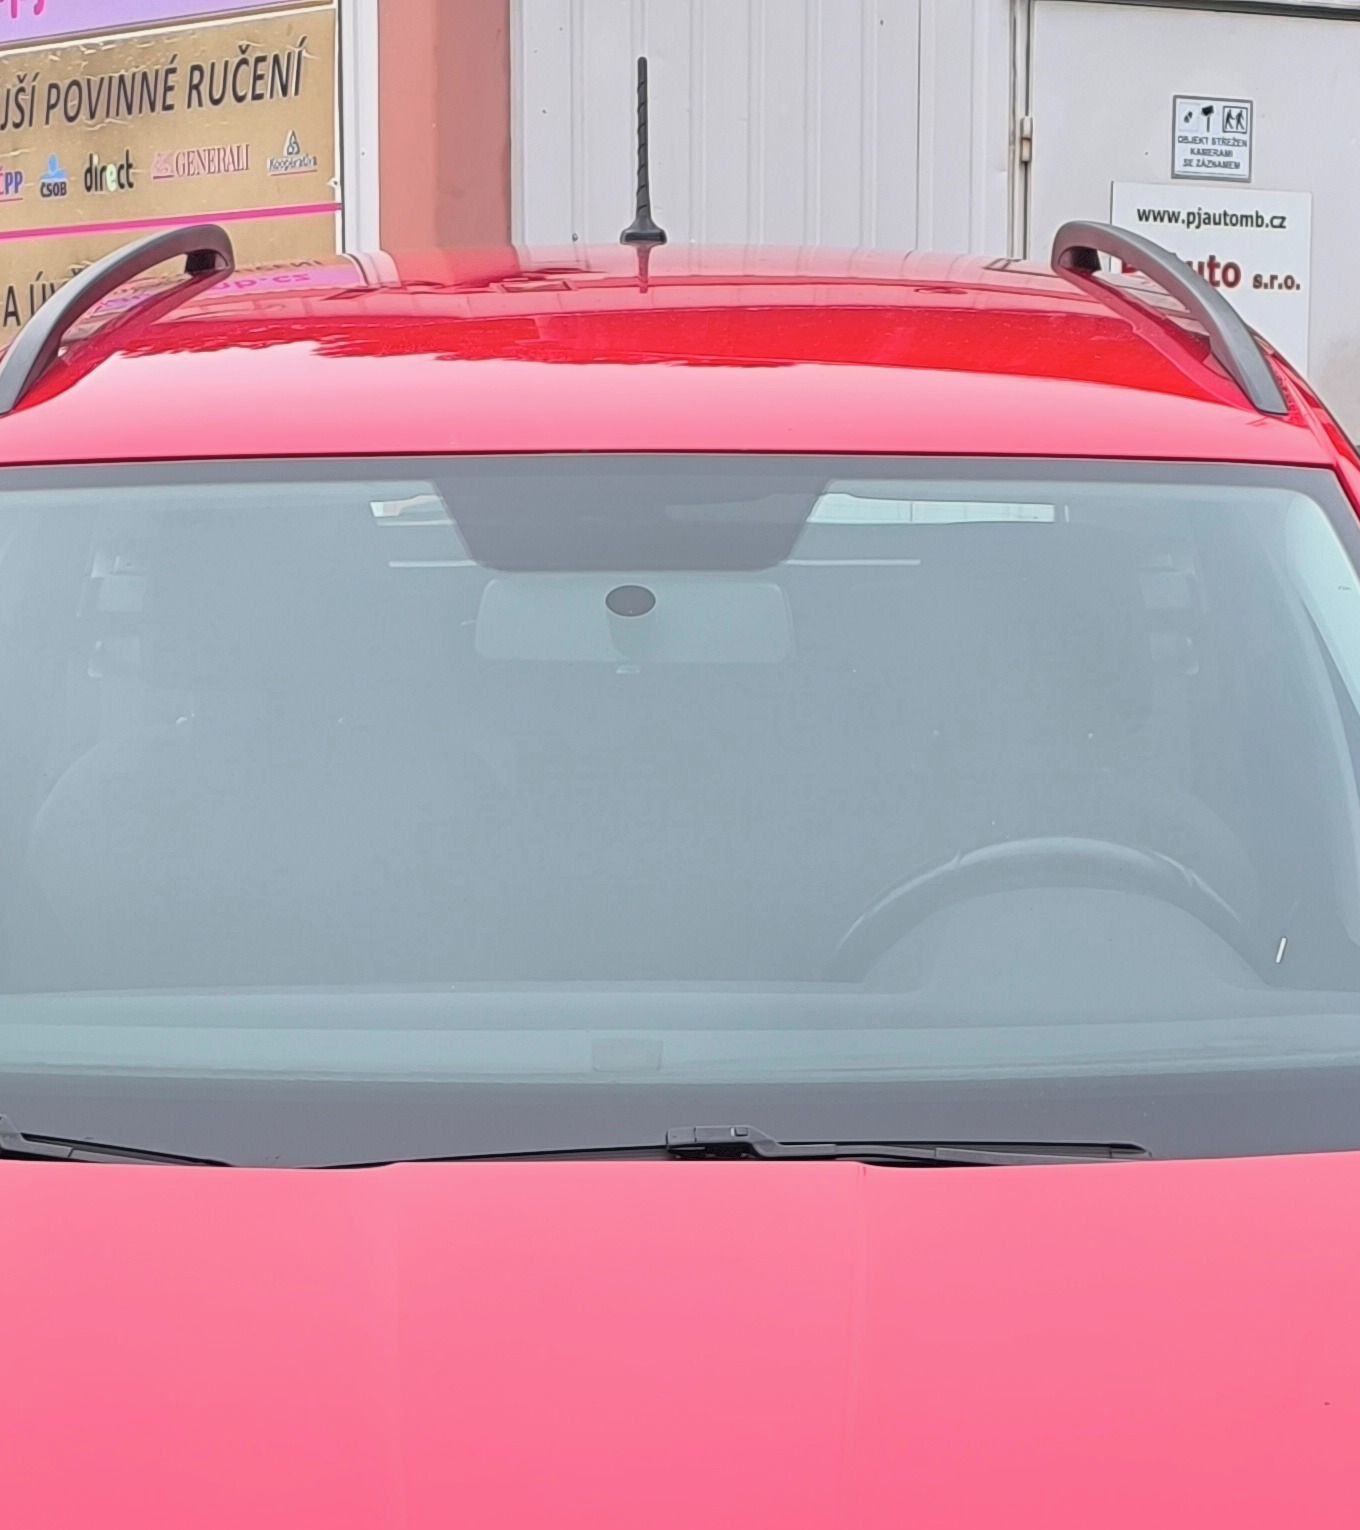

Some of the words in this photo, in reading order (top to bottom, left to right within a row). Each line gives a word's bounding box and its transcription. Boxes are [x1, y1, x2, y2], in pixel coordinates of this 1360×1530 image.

[45, 53, 178, 126] POVINNÉ
[187, 35, 307, 109] RUČENÍ
[84, 149, 134, 193] direct
[175, 144, 250, 178] GENERALI
[1137, 207, 1287, 230] www.pjautomb.cz
[1183, 254, 1242, 289] uto
[1252, 272, 1301, 290] s.r.o.
[3, 285, 22, 328] A
